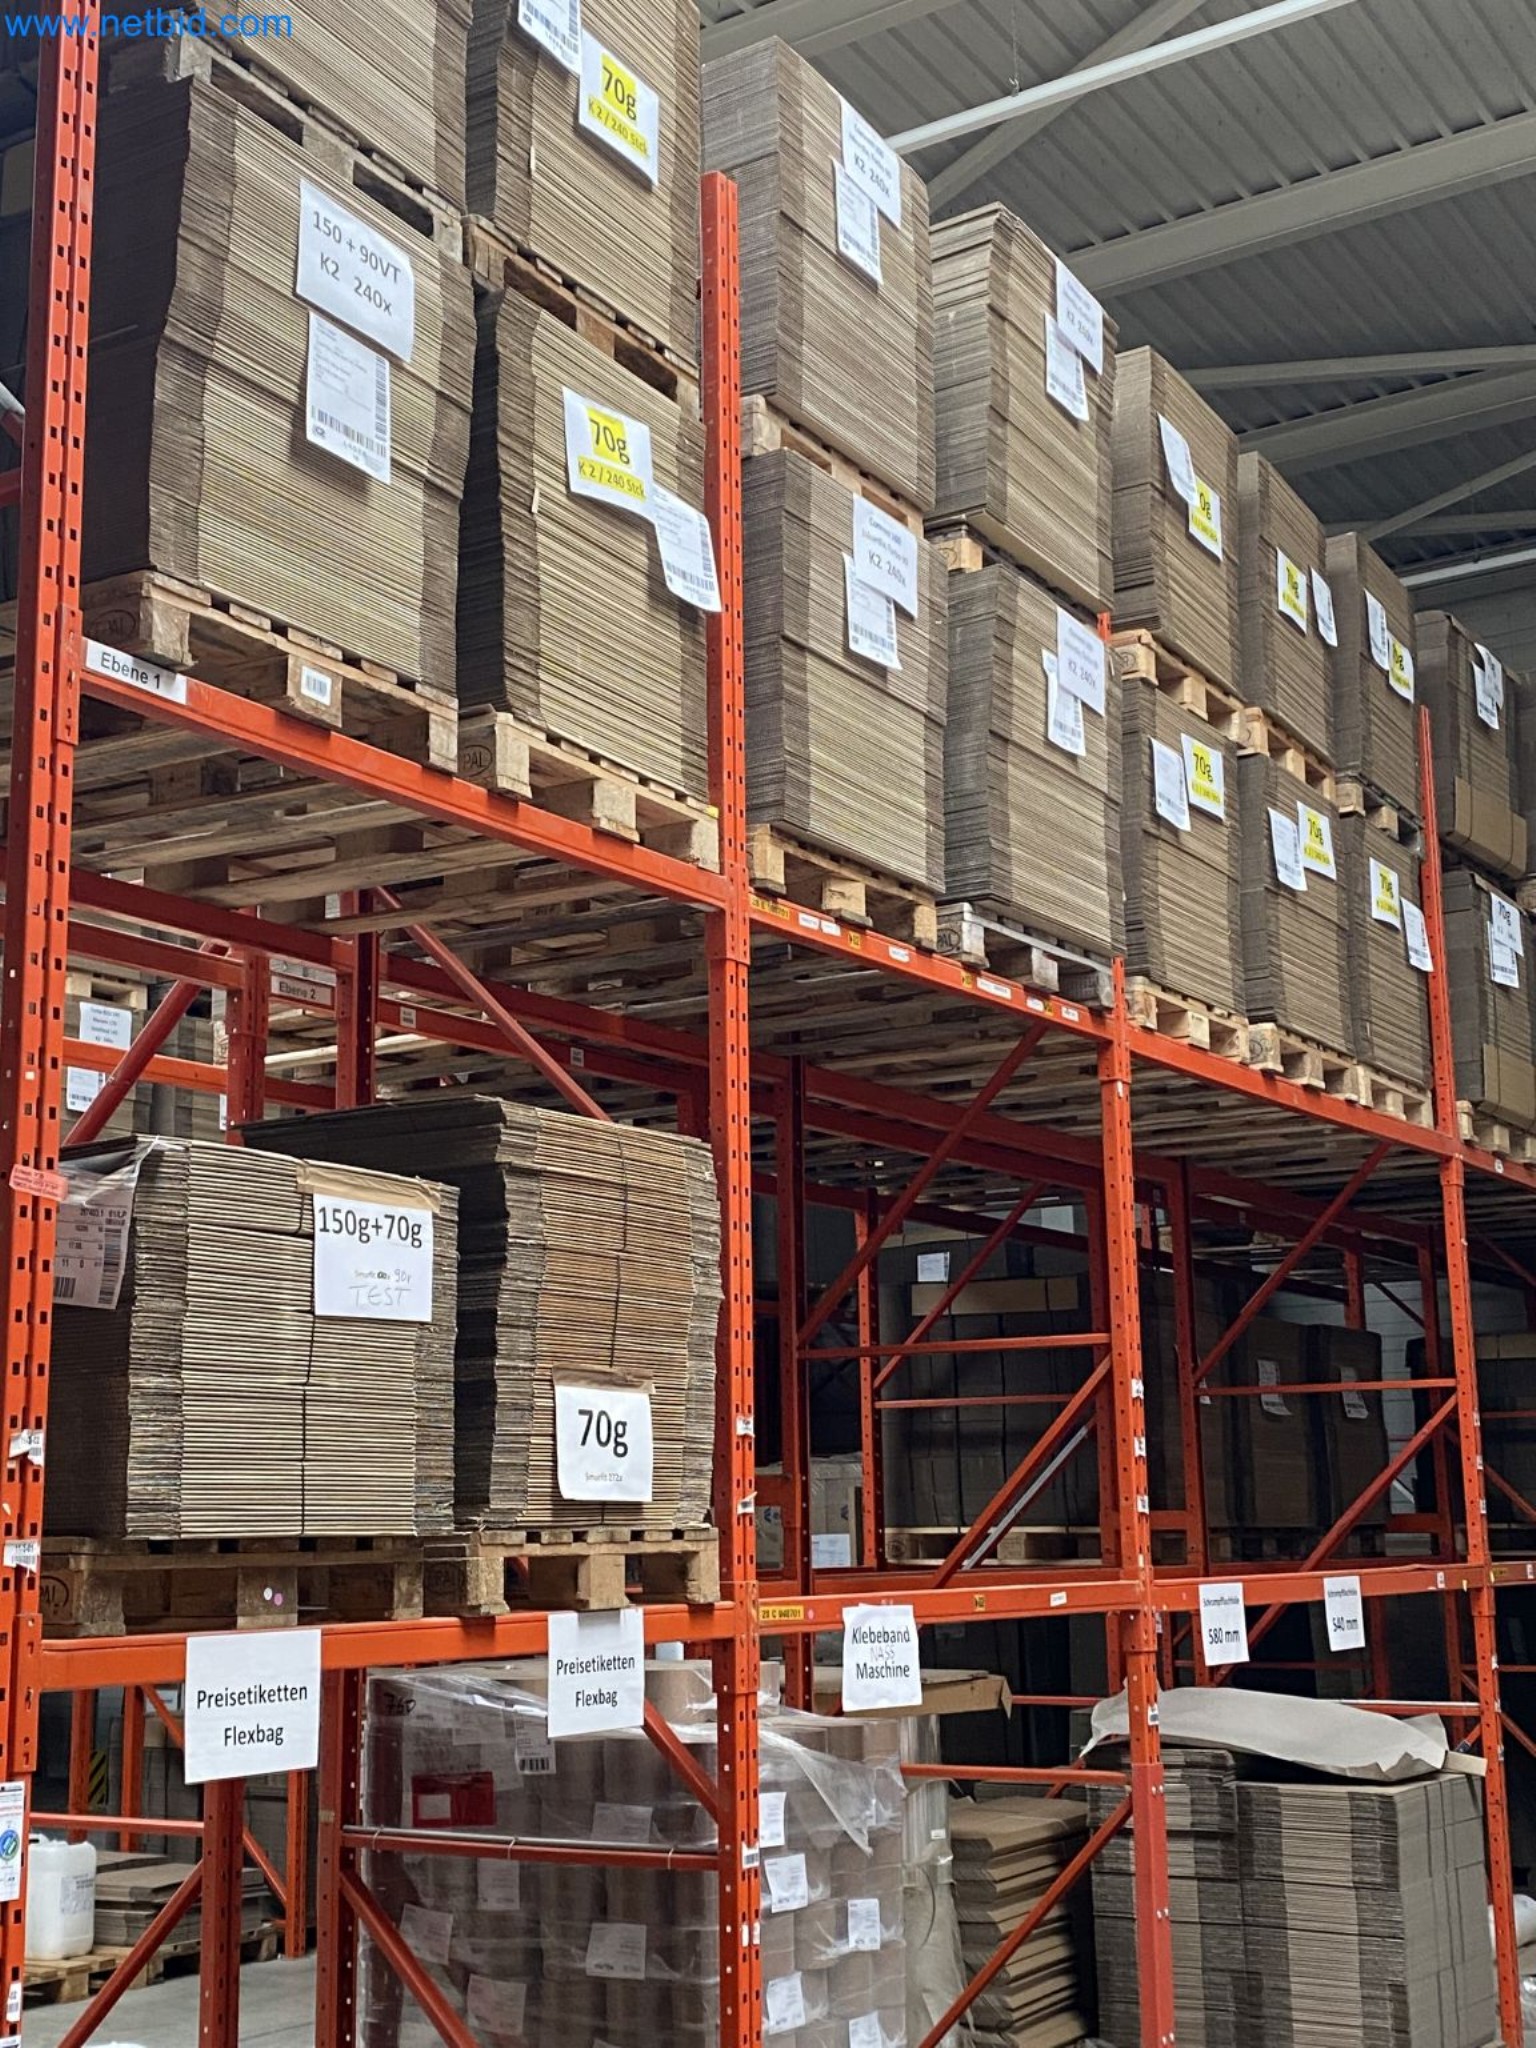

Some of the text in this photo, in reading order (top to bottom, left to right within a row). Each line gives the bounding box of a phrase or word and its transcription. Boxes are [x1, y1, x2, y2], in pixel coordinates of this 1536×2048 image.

[602, 64, 637, 122] 70g
[611, 117, 629, 139] 240
[313, 210, 402, 284] 150 + 90VT
[320, 252, 393, 316] K2 240x
[589, 417, 631, 465] 70g
[606, 468, 625, 489] 240
[101, 651, 162, 690] Ebene 1
[279, 981, 317, 1000] Ebene 2
[318, 1206, 422, 1249] 150g+70g
[348, 1284, 412, 1307] TEST
[578, 1408, 629, 1458] 70g
[851, 1626, 911, 1645] Klebeband
[1208, 1627, 1240, 1645] 580 mm
[556, 1654, 635, 1676] Preisetiketten
[856, 1661, 910, 1680] Maschine
[197, 1684, 308, 1709] Preisetiketten
[575, 1688, 618, 1707] Flexbag
[224, 1723, 284, 1747] Flexbag
